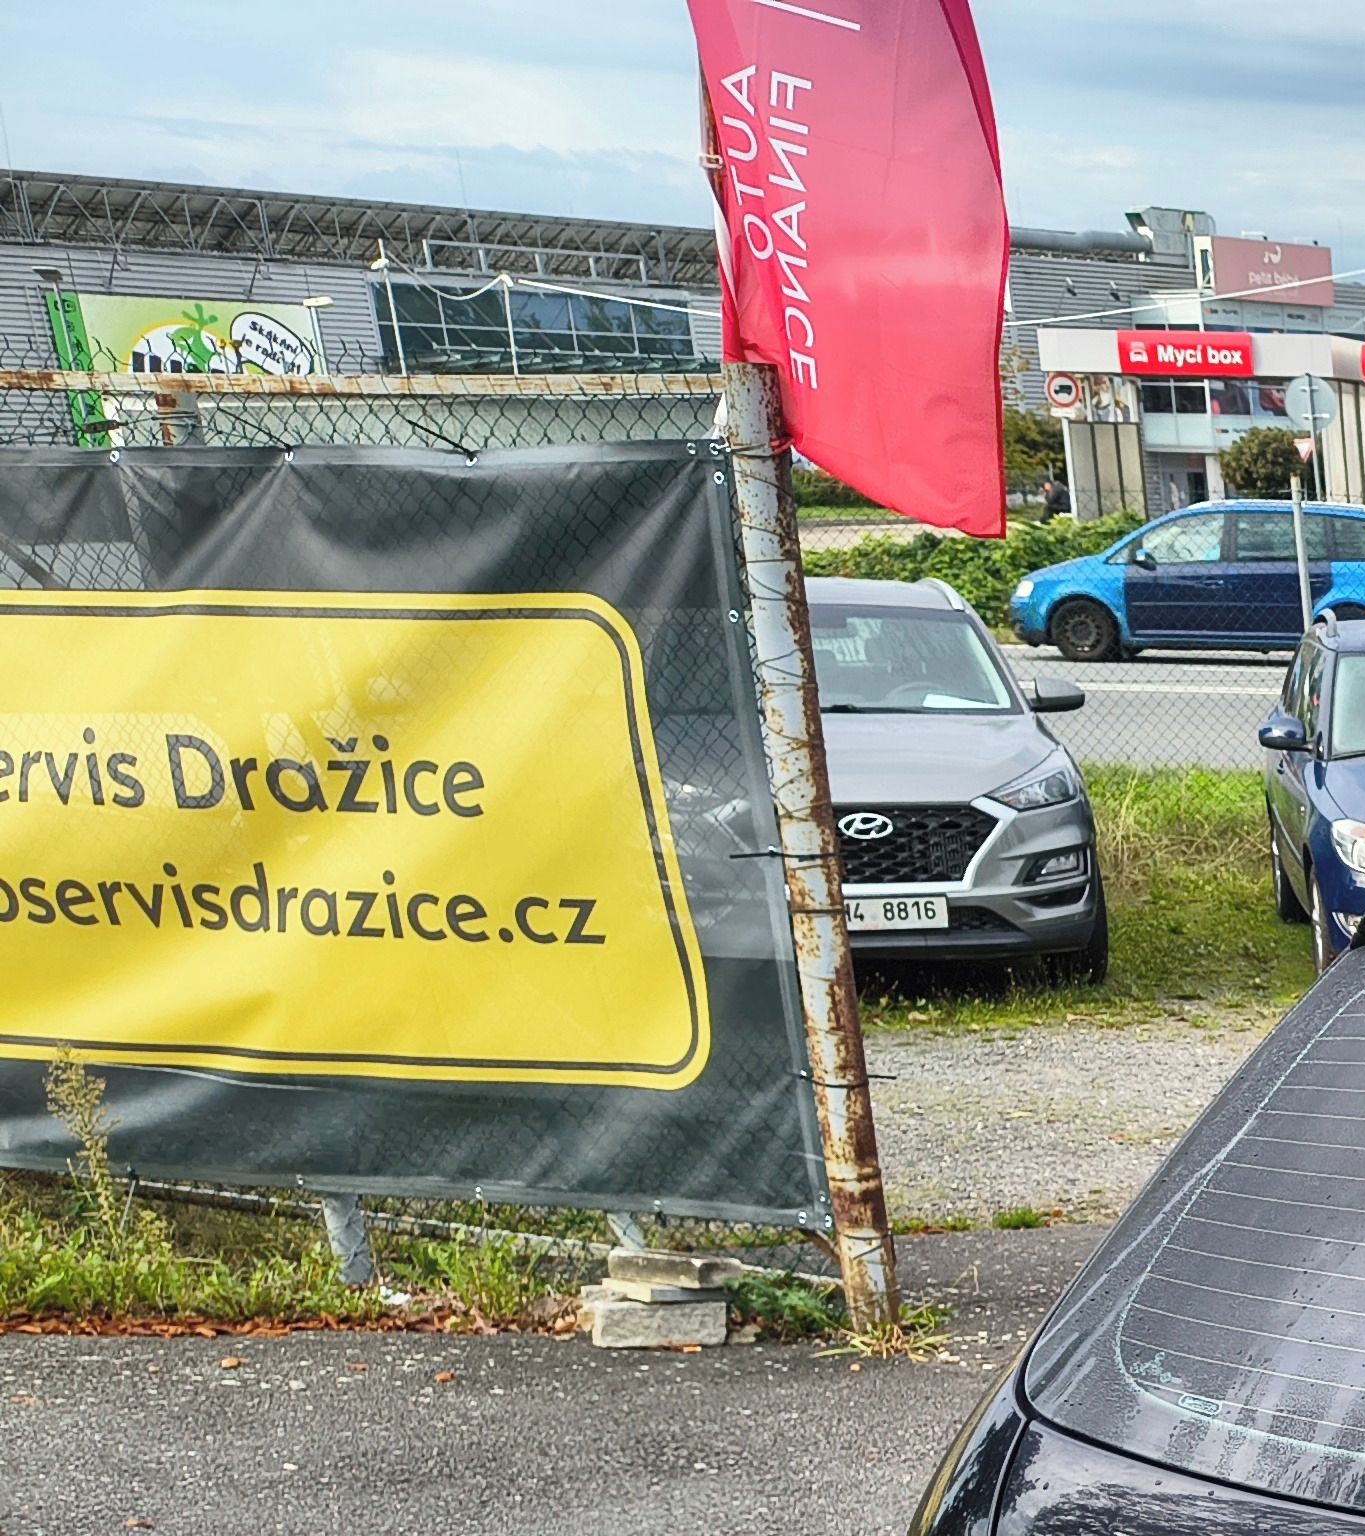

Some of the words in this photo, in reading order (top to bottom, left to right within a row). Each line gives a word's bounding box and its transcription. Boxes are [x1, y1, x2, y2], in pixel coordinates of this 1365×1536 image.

[1157, 344, 1202, 367] Mycí
[1207, 346, 1243, 365] box
[166, 733, 485, 818] Dražice
[883, 900, 937, 921] 8816
